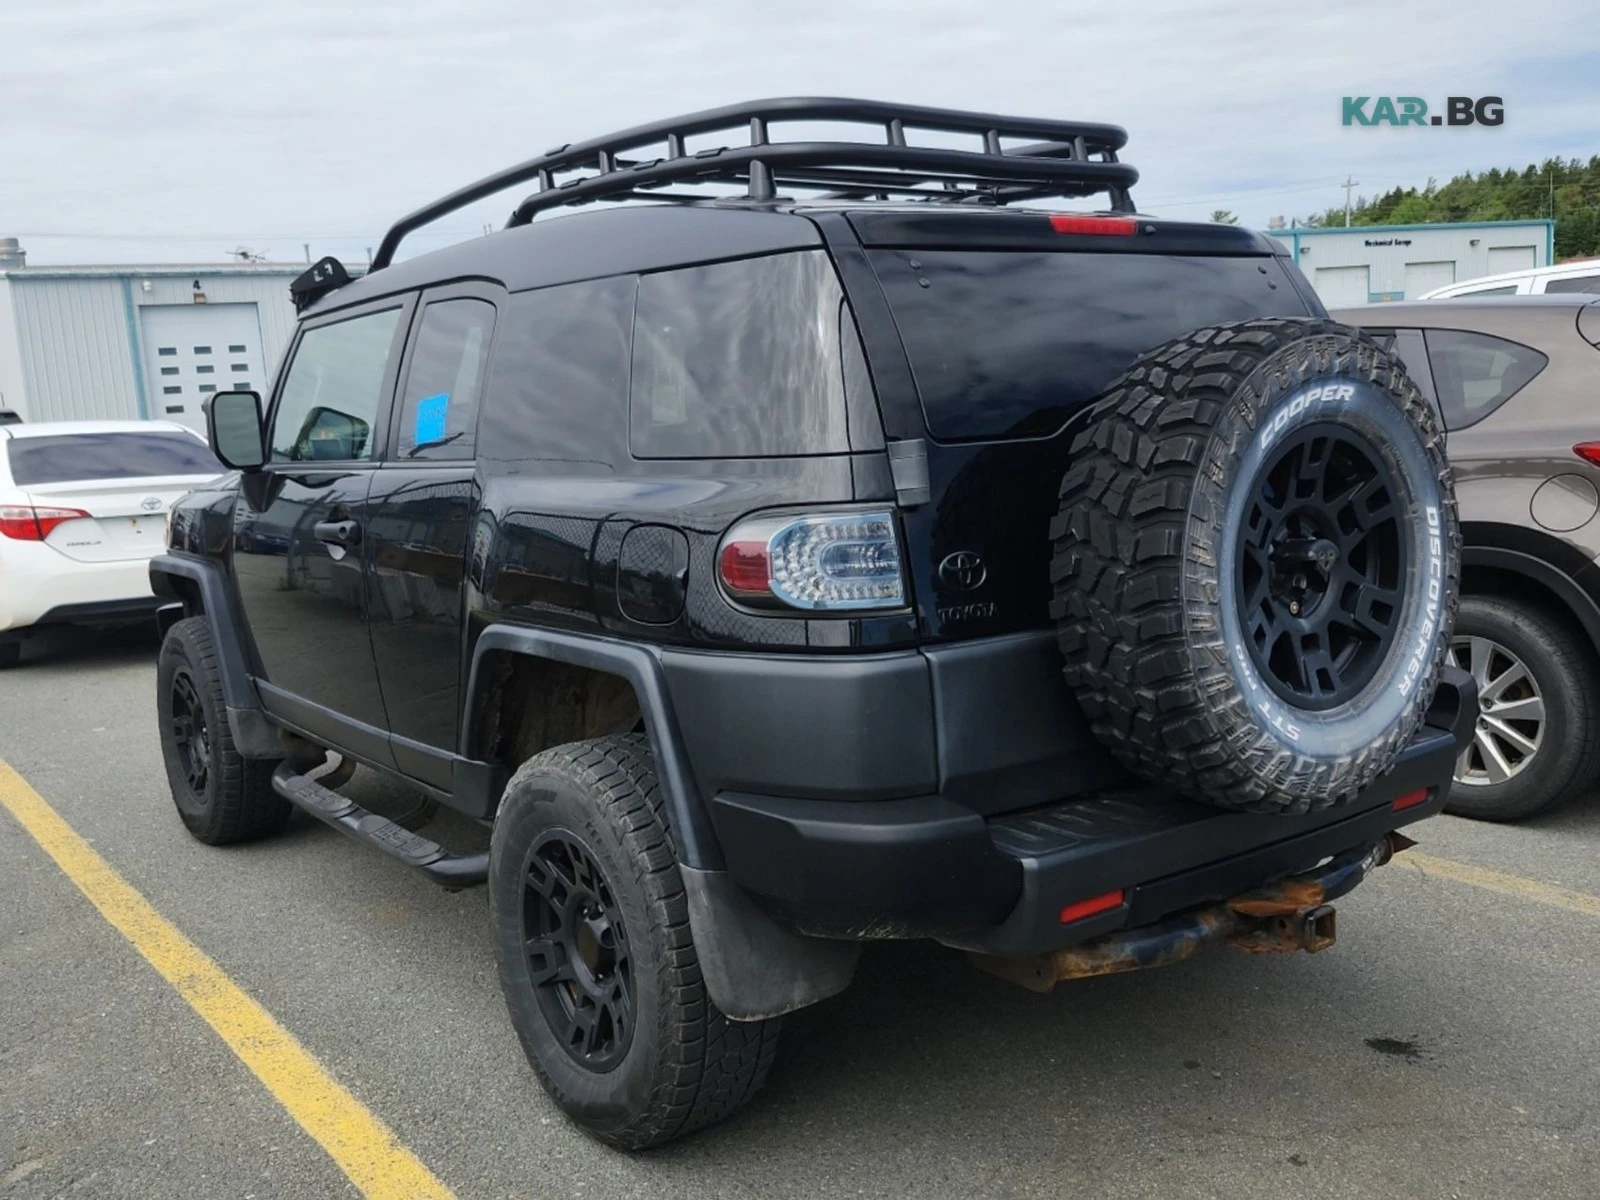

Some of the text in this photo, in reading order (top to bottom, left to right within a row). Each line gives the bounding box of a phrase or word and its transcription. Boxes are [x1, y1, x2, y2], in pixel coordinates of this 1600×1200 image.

[1261, 384, 1355, 450] COOPER
[1398, 505, 1442, 698] DISCOVERER
[1258, 702, 1301, 742] STT
